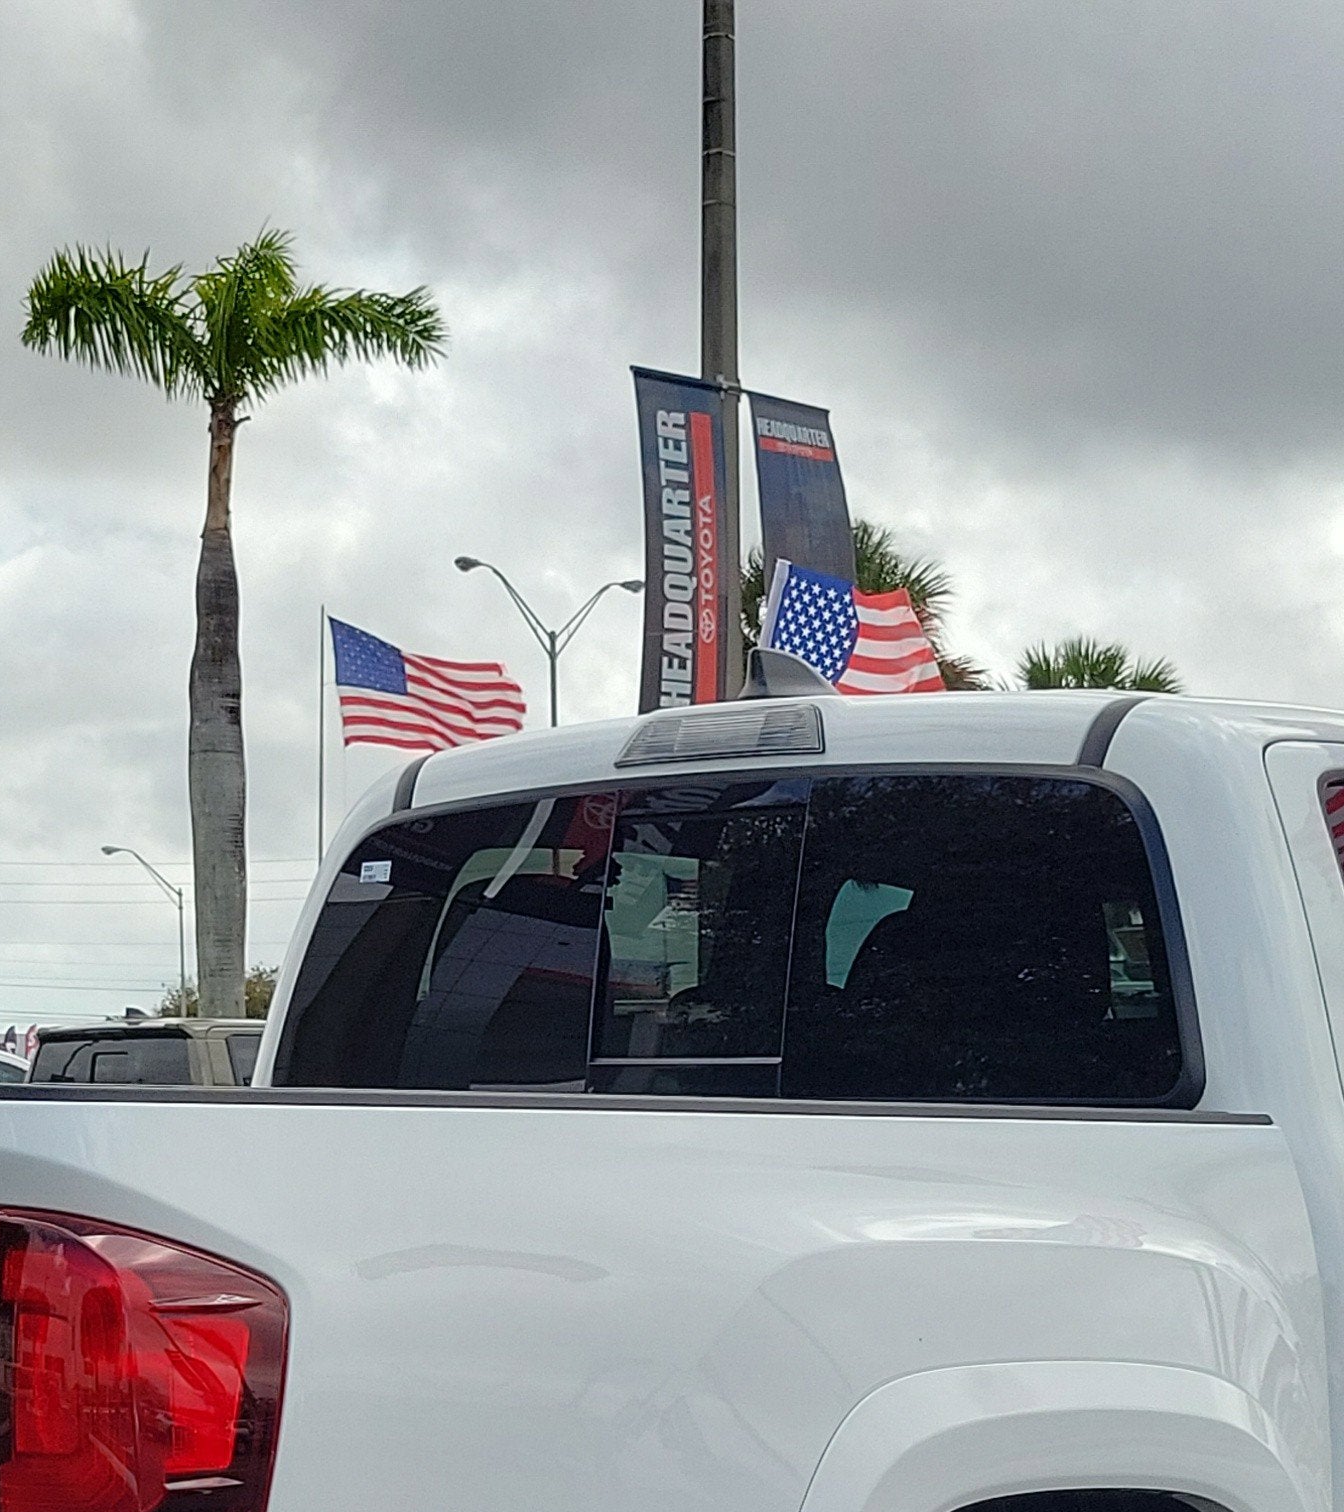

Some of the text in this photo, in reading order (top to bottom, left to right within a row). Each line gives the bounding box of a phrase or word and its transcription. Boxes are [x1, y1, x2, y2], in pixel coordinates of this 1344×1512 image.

[756, 417, 830, 448] HEADQUARTER
[657, 409, 697, 708] HEADQUARTER
[699, 495, 714, 602] TOYOTA
